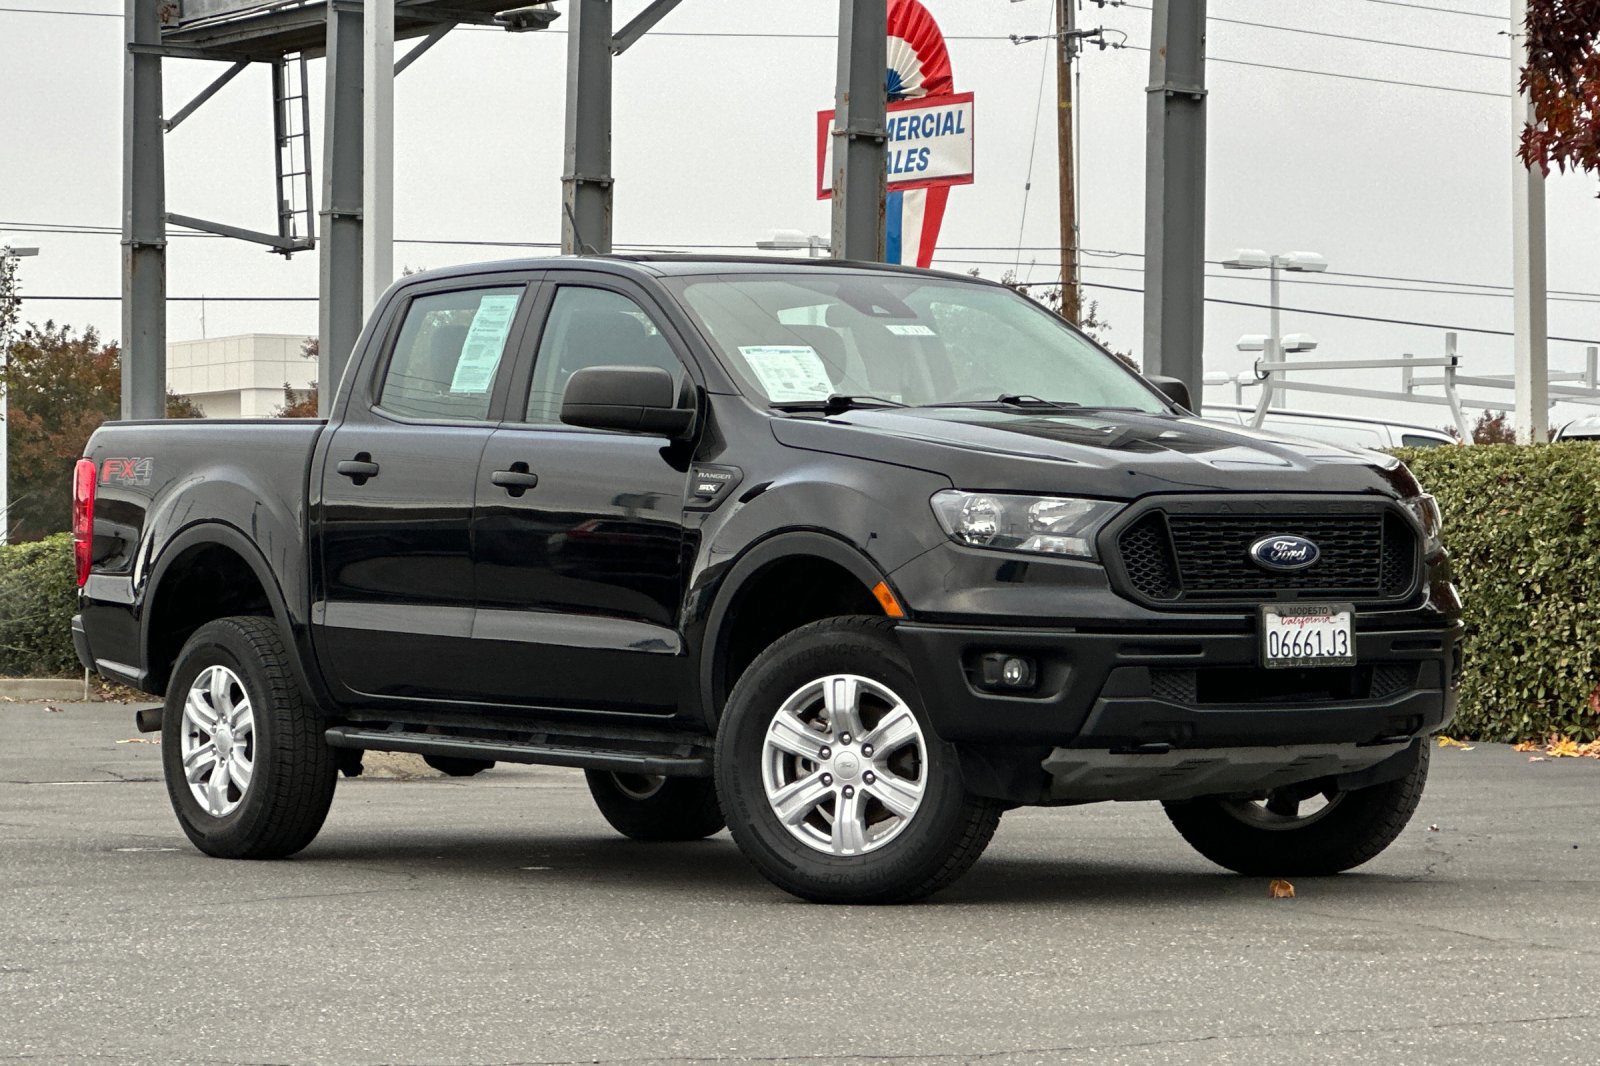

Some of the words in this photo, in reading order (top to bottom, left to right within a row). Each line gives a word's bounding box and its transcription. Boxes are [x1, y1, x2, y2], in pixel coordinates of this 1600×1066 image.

[887, 110, 965, 142] MERCIAL
[887, 147, 930, 175] ALES
[102, 457, 154, 485] FX4
[1271, 540, 1307, 561] Ford
[1281, 616, 1336, 629] California
[1289, 606, 1328, 615] MODESTO
[1269, 629, 1347, 658] 06661J3
